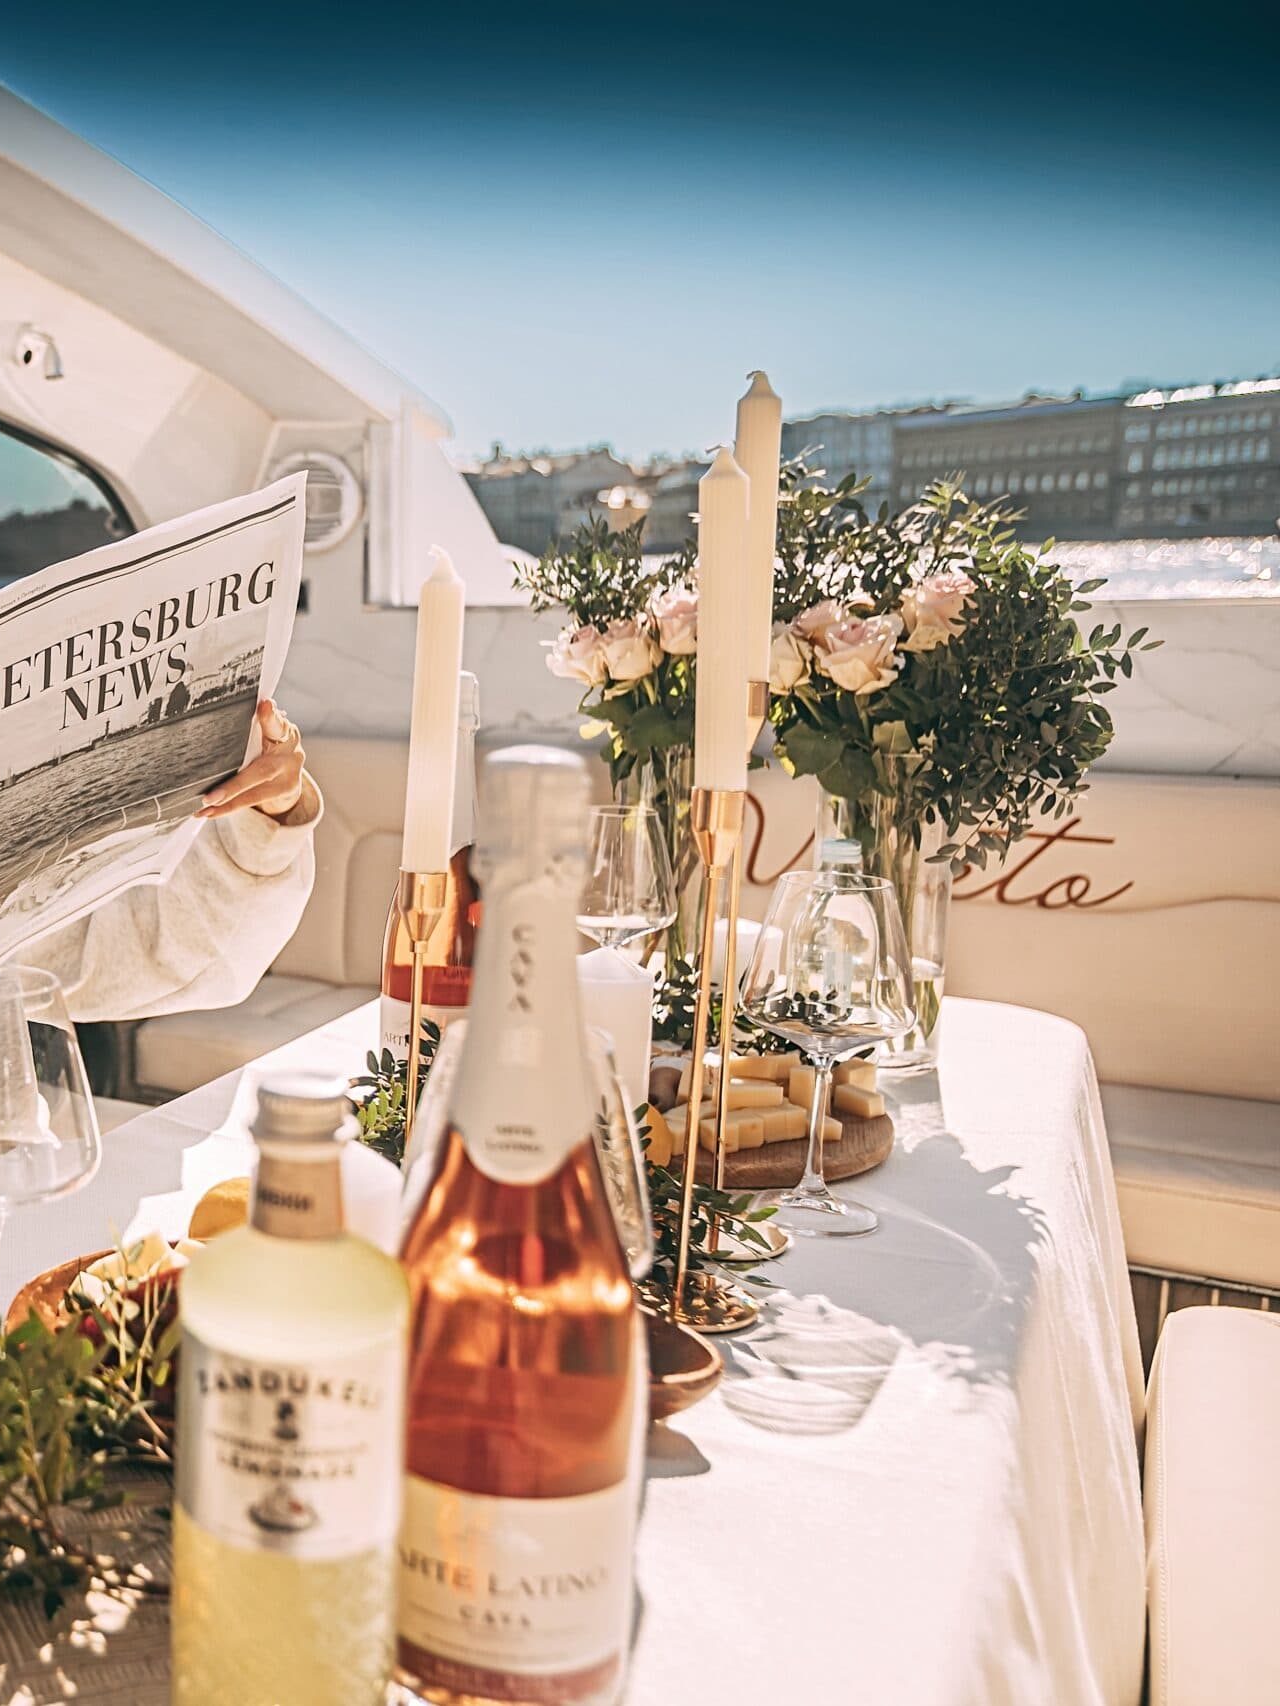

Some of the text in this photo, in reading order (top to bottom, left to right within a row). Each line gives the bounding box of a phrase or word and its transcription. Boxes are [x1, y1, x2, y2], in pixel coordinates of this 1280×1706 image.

[59, 641, 187, 731] NEWS
[509, 923, 535, 1014] CAVA
[383, 1031, 410, 1048] ART
